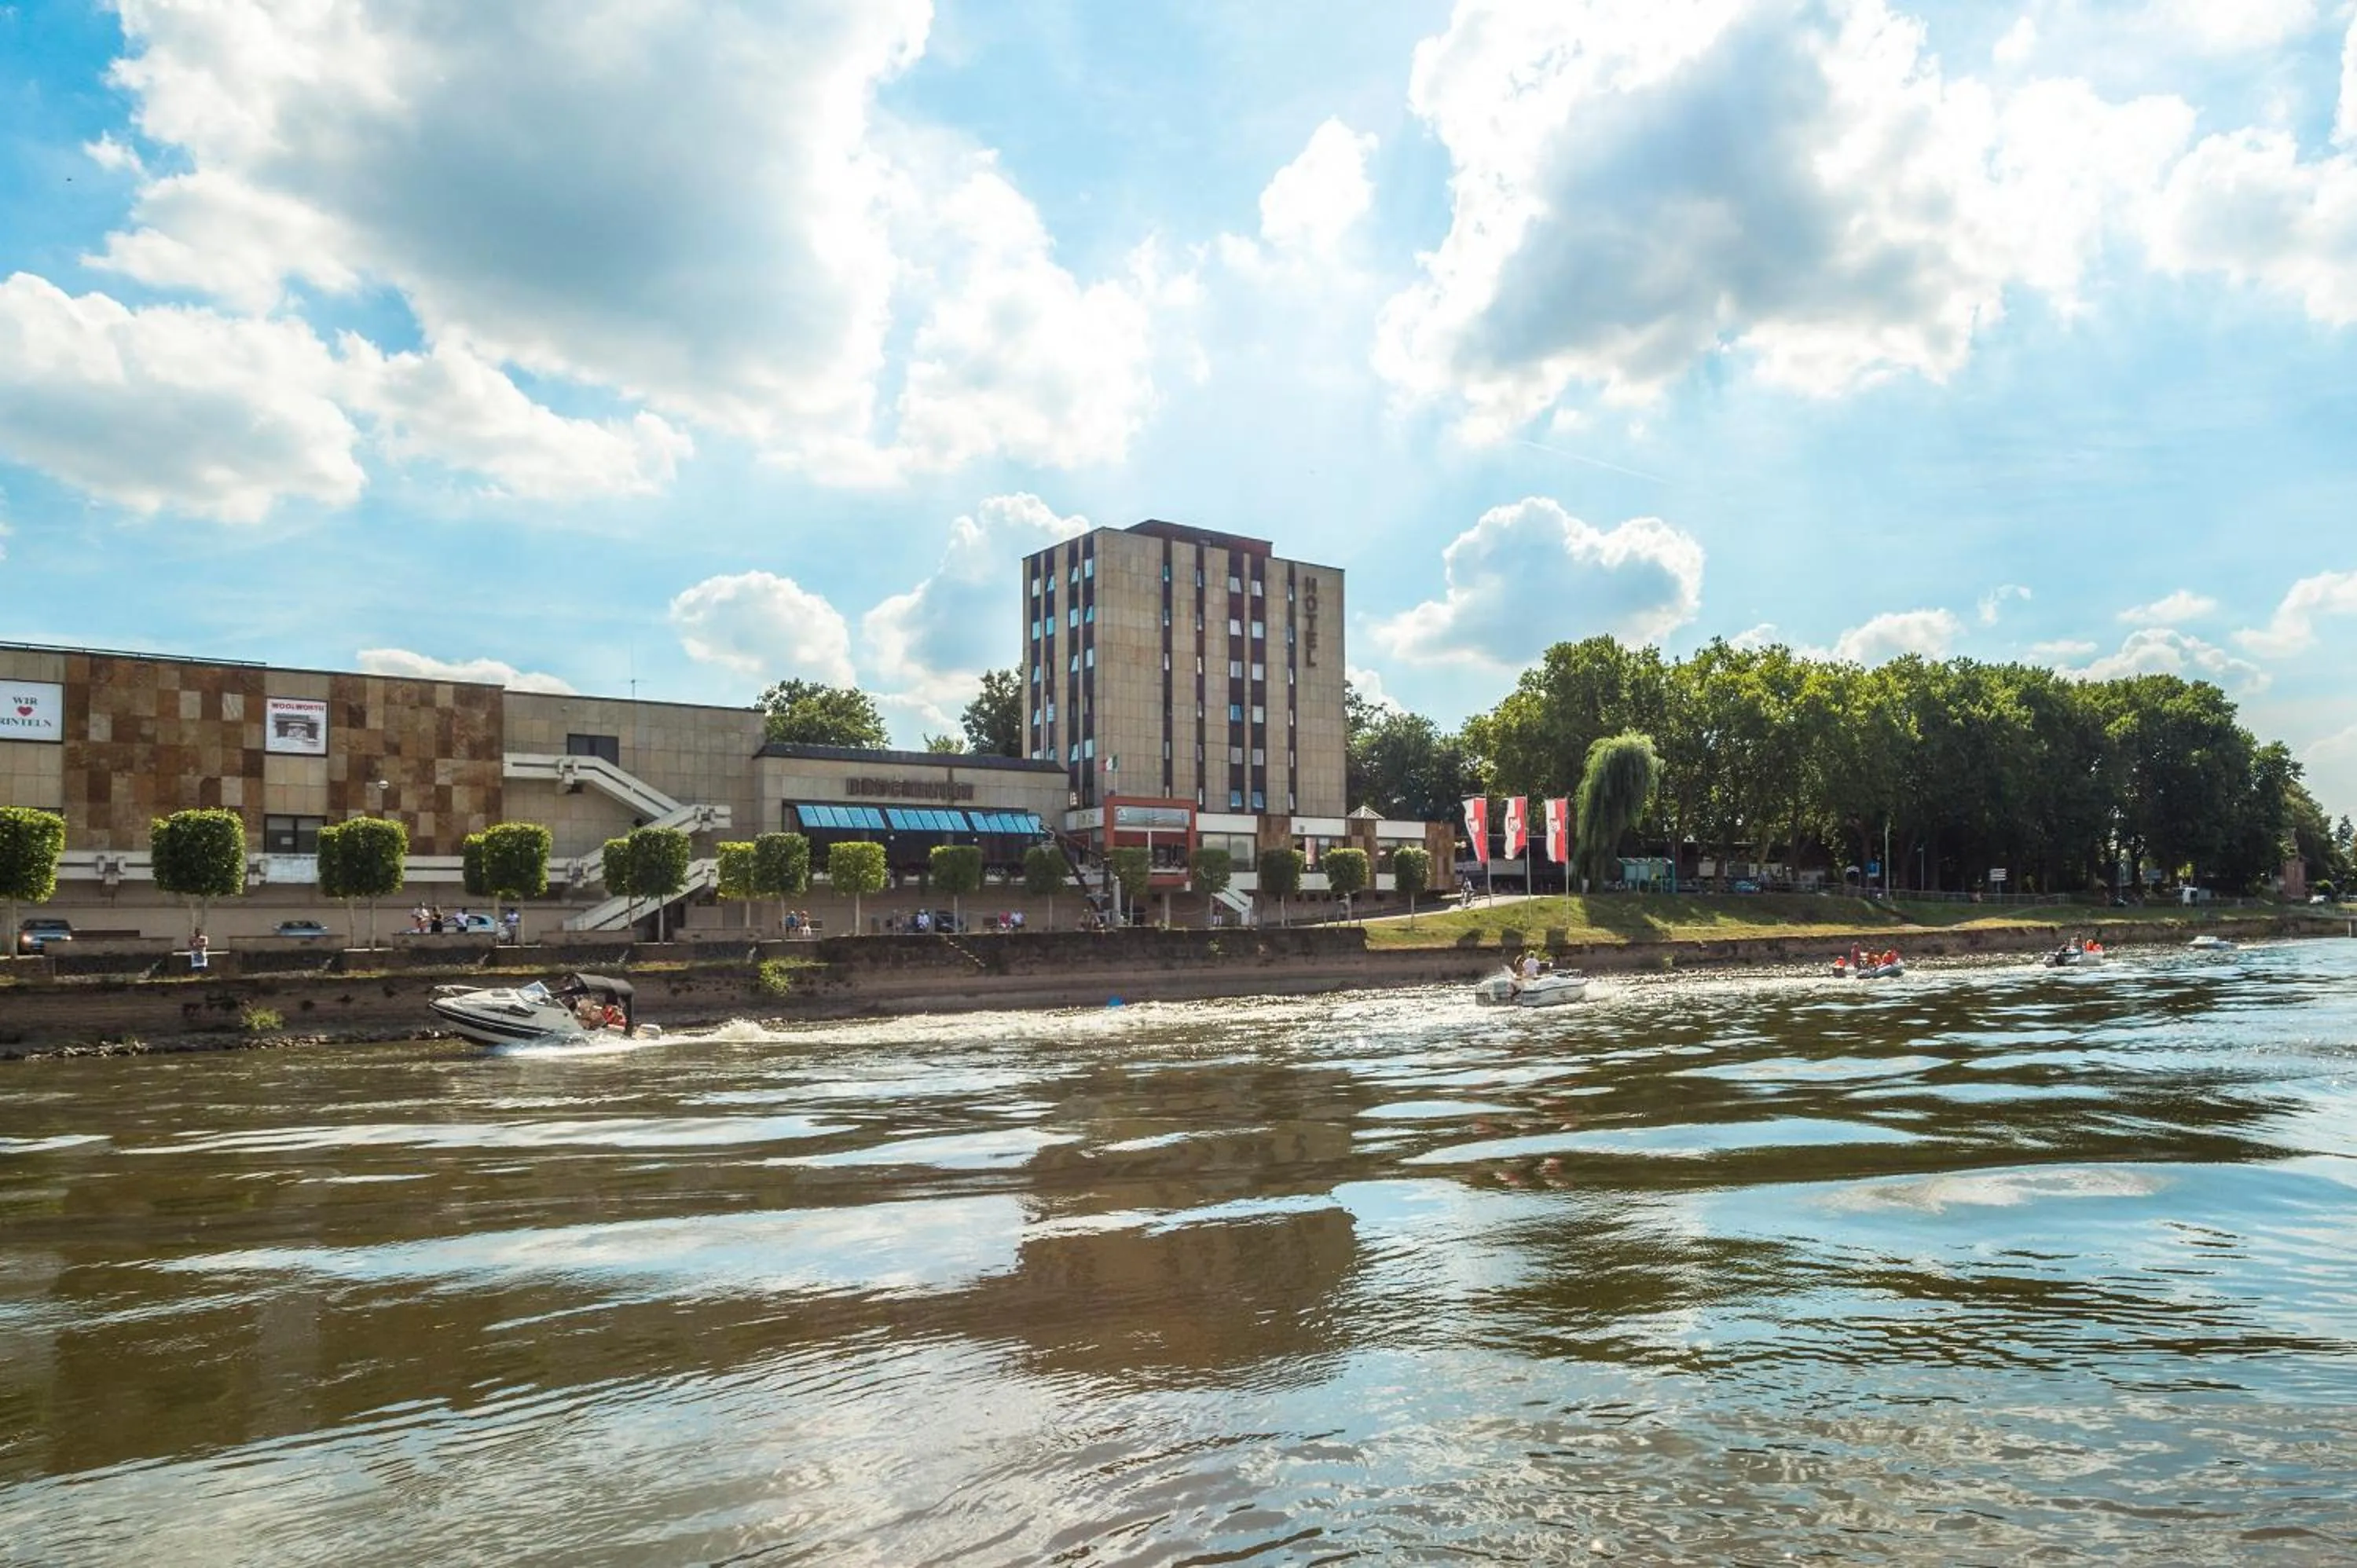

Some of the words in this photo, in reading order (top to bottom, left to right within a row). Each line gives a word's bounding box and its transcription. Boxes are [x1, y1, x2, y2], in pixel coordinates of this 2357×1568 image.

[1305, 576, 1318, 668] HOTEL
[13, 696, 38, 706] WIR
[271, 702, 324, 712] WOOLWORTH
